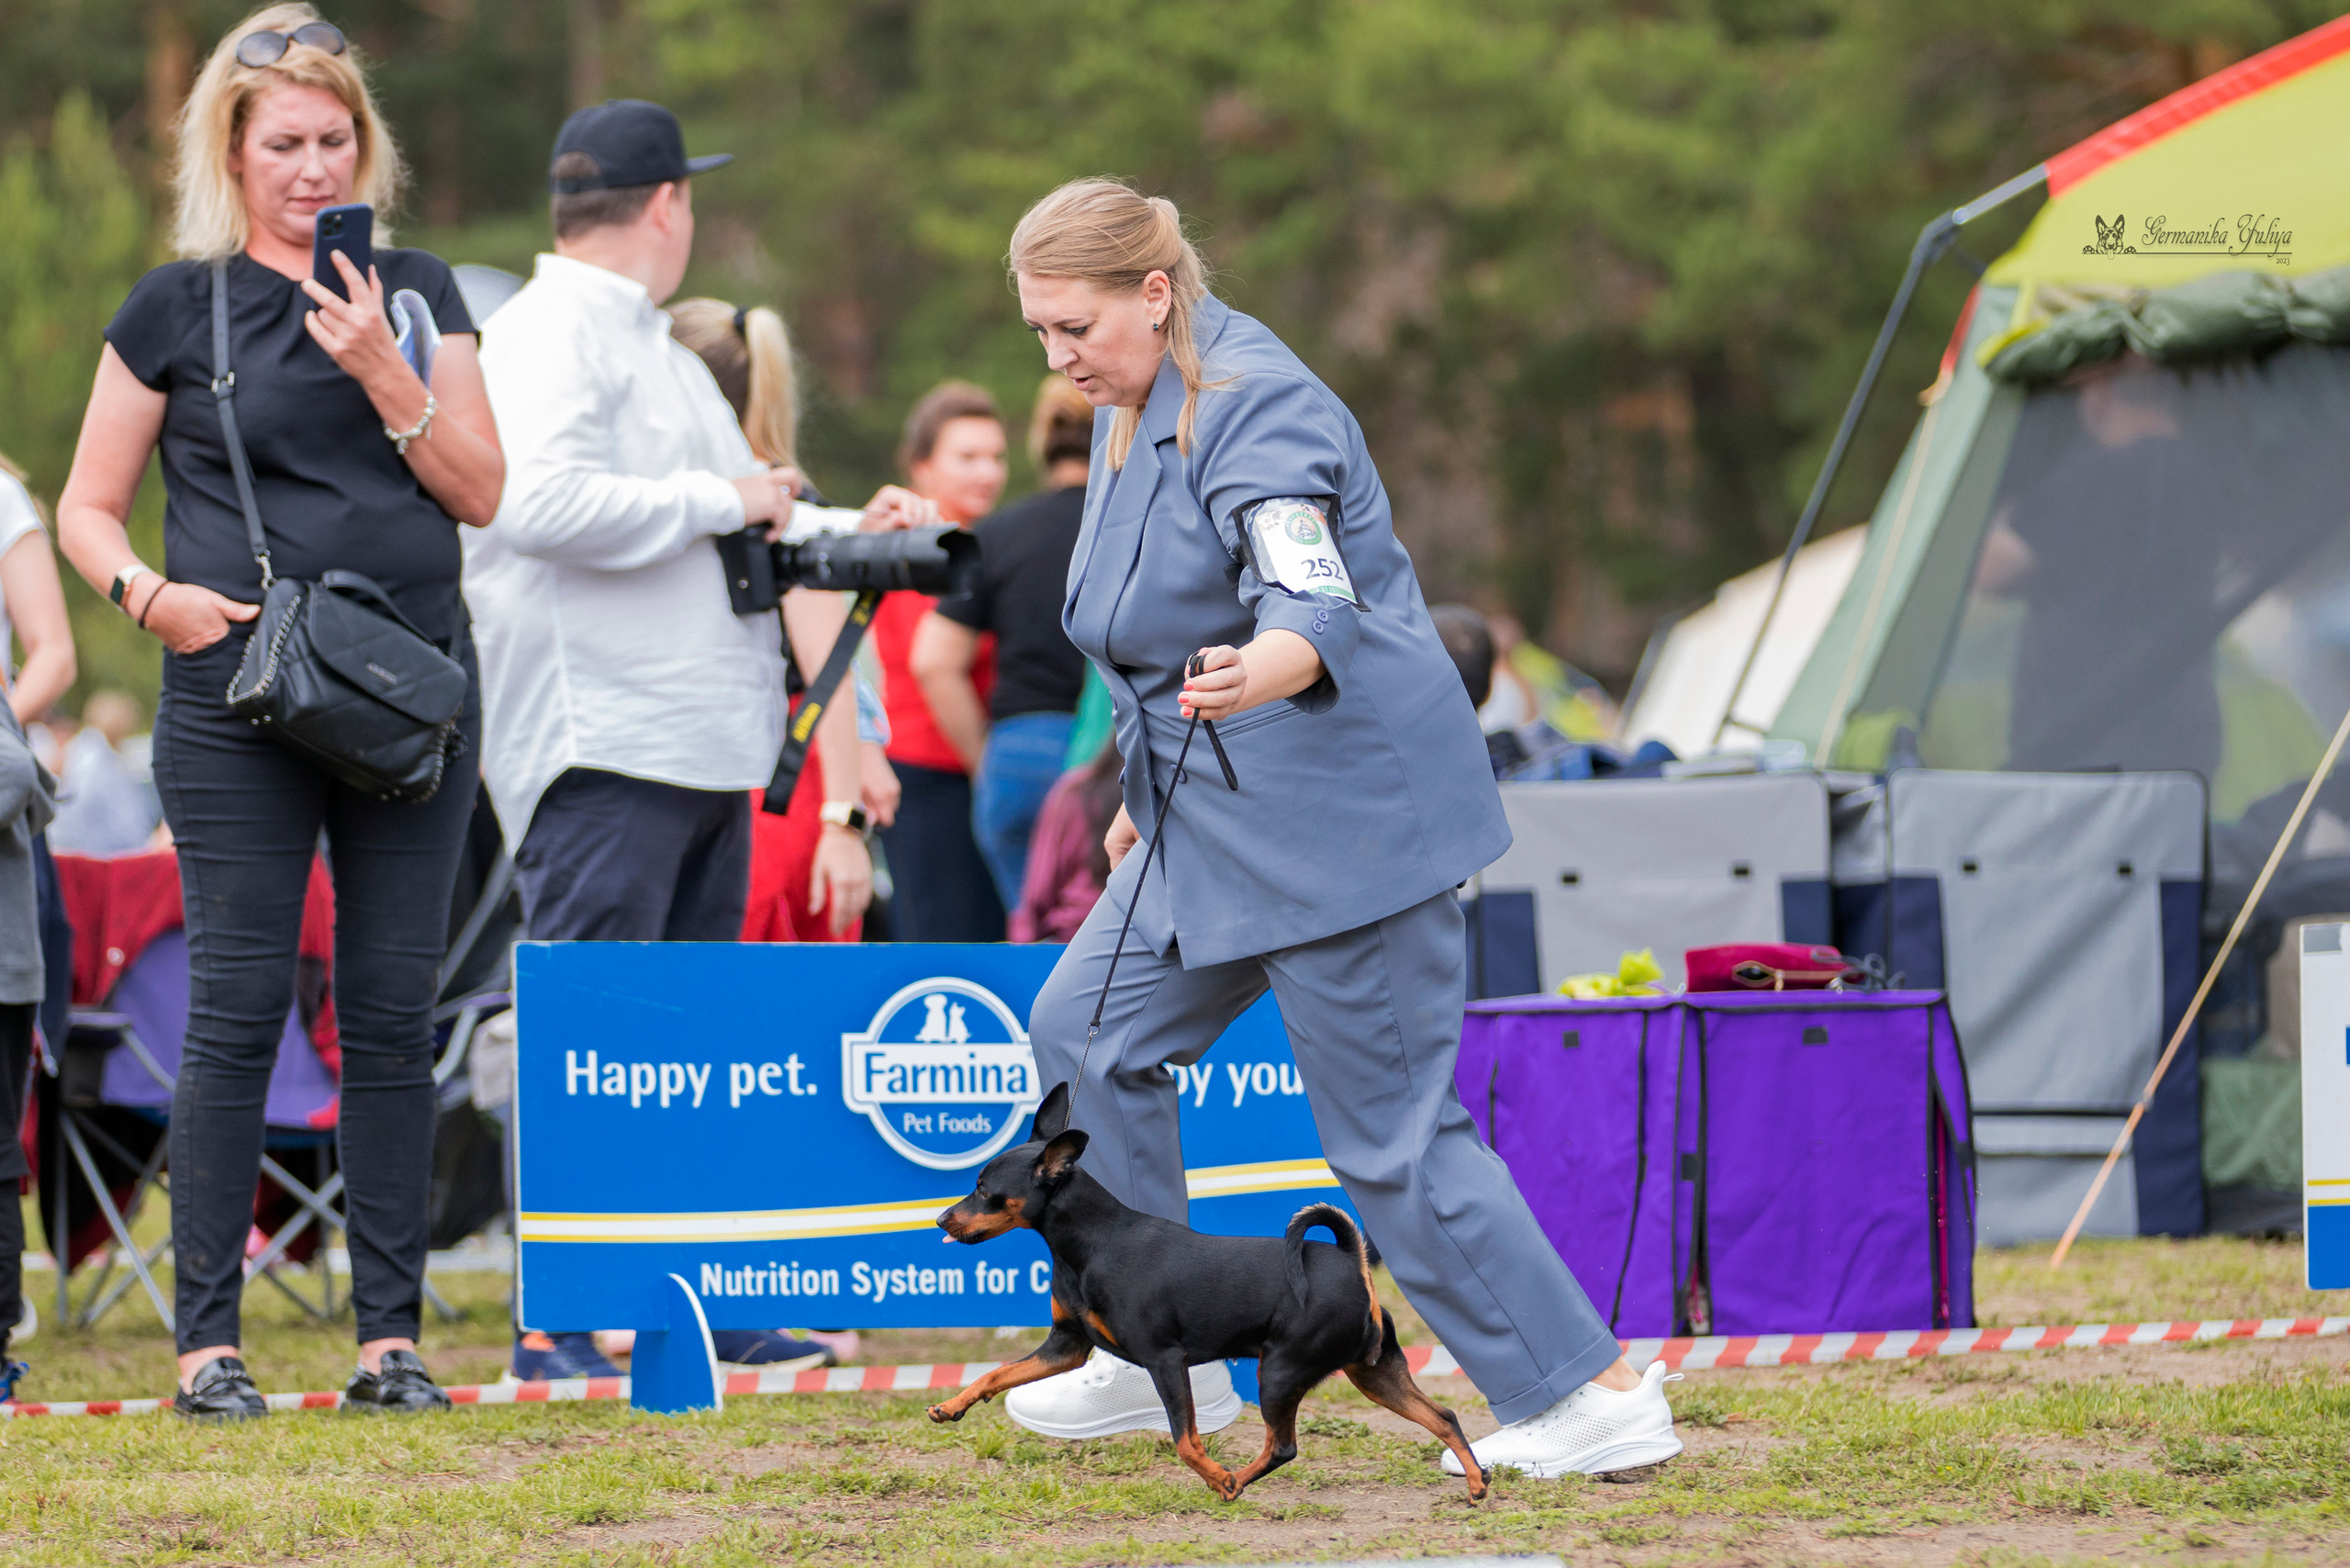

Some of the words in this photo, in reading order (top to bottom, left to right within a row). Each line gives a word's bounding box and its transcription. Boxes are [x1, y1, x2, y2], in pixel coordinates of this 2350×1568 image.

[1300, 558, 1345, 581] 252
[565, 1049, 711, 1108] Happy
[730, 1053, 819, 1108] pet.
[864, 1051, 1028, 1094] Farmina
[902, 1112, 934, 1134] Pet
[938, 1112, 993, 1134] Foods
[700, 1260, 840, 1297] Nutrition
[851, 1260, 965, 1303] System
[975, 1260, 1020, 1294] for
